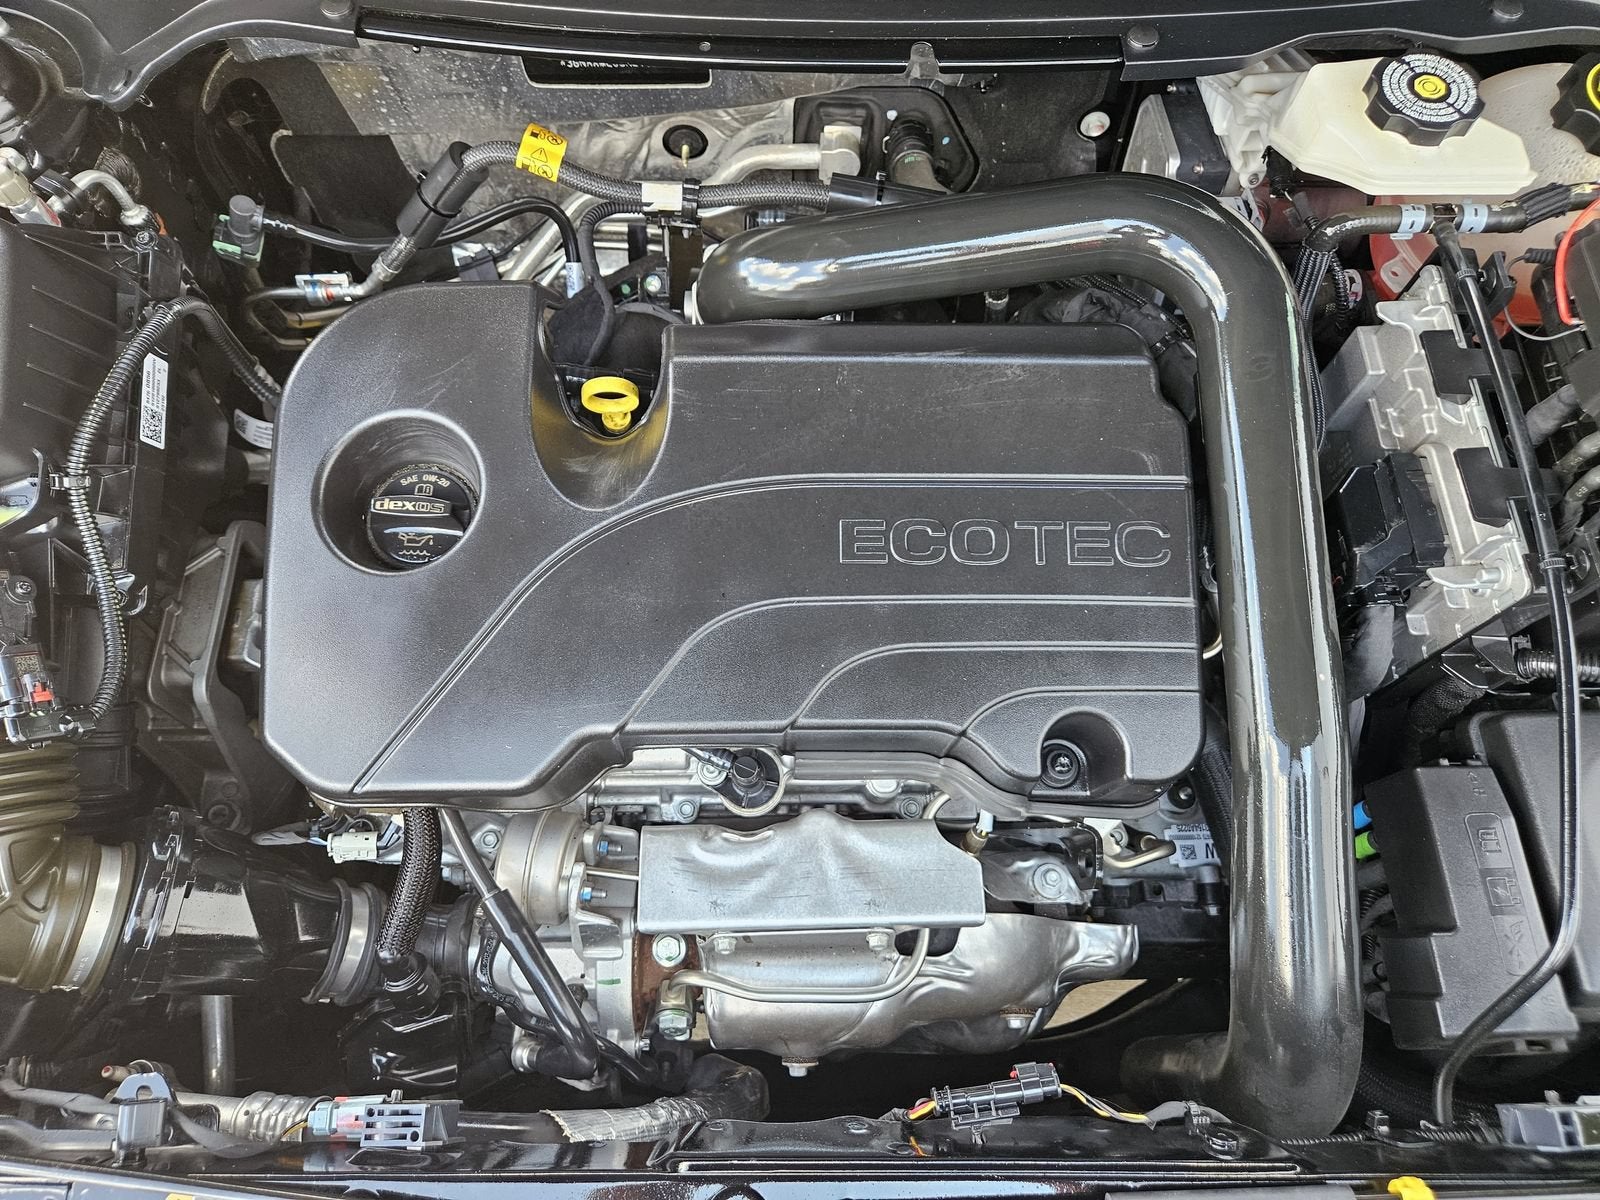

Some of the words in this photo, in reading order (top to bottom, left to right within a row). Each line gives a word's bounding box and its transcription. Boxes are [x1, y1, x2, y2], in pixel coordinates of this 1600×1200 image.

[400, 474, 418, 486] SAE
[422, 473, 451, 488] 0W-20
[374, 498, 444, 513] dexos
[838, 518, 1171, 567] ECOTEC
